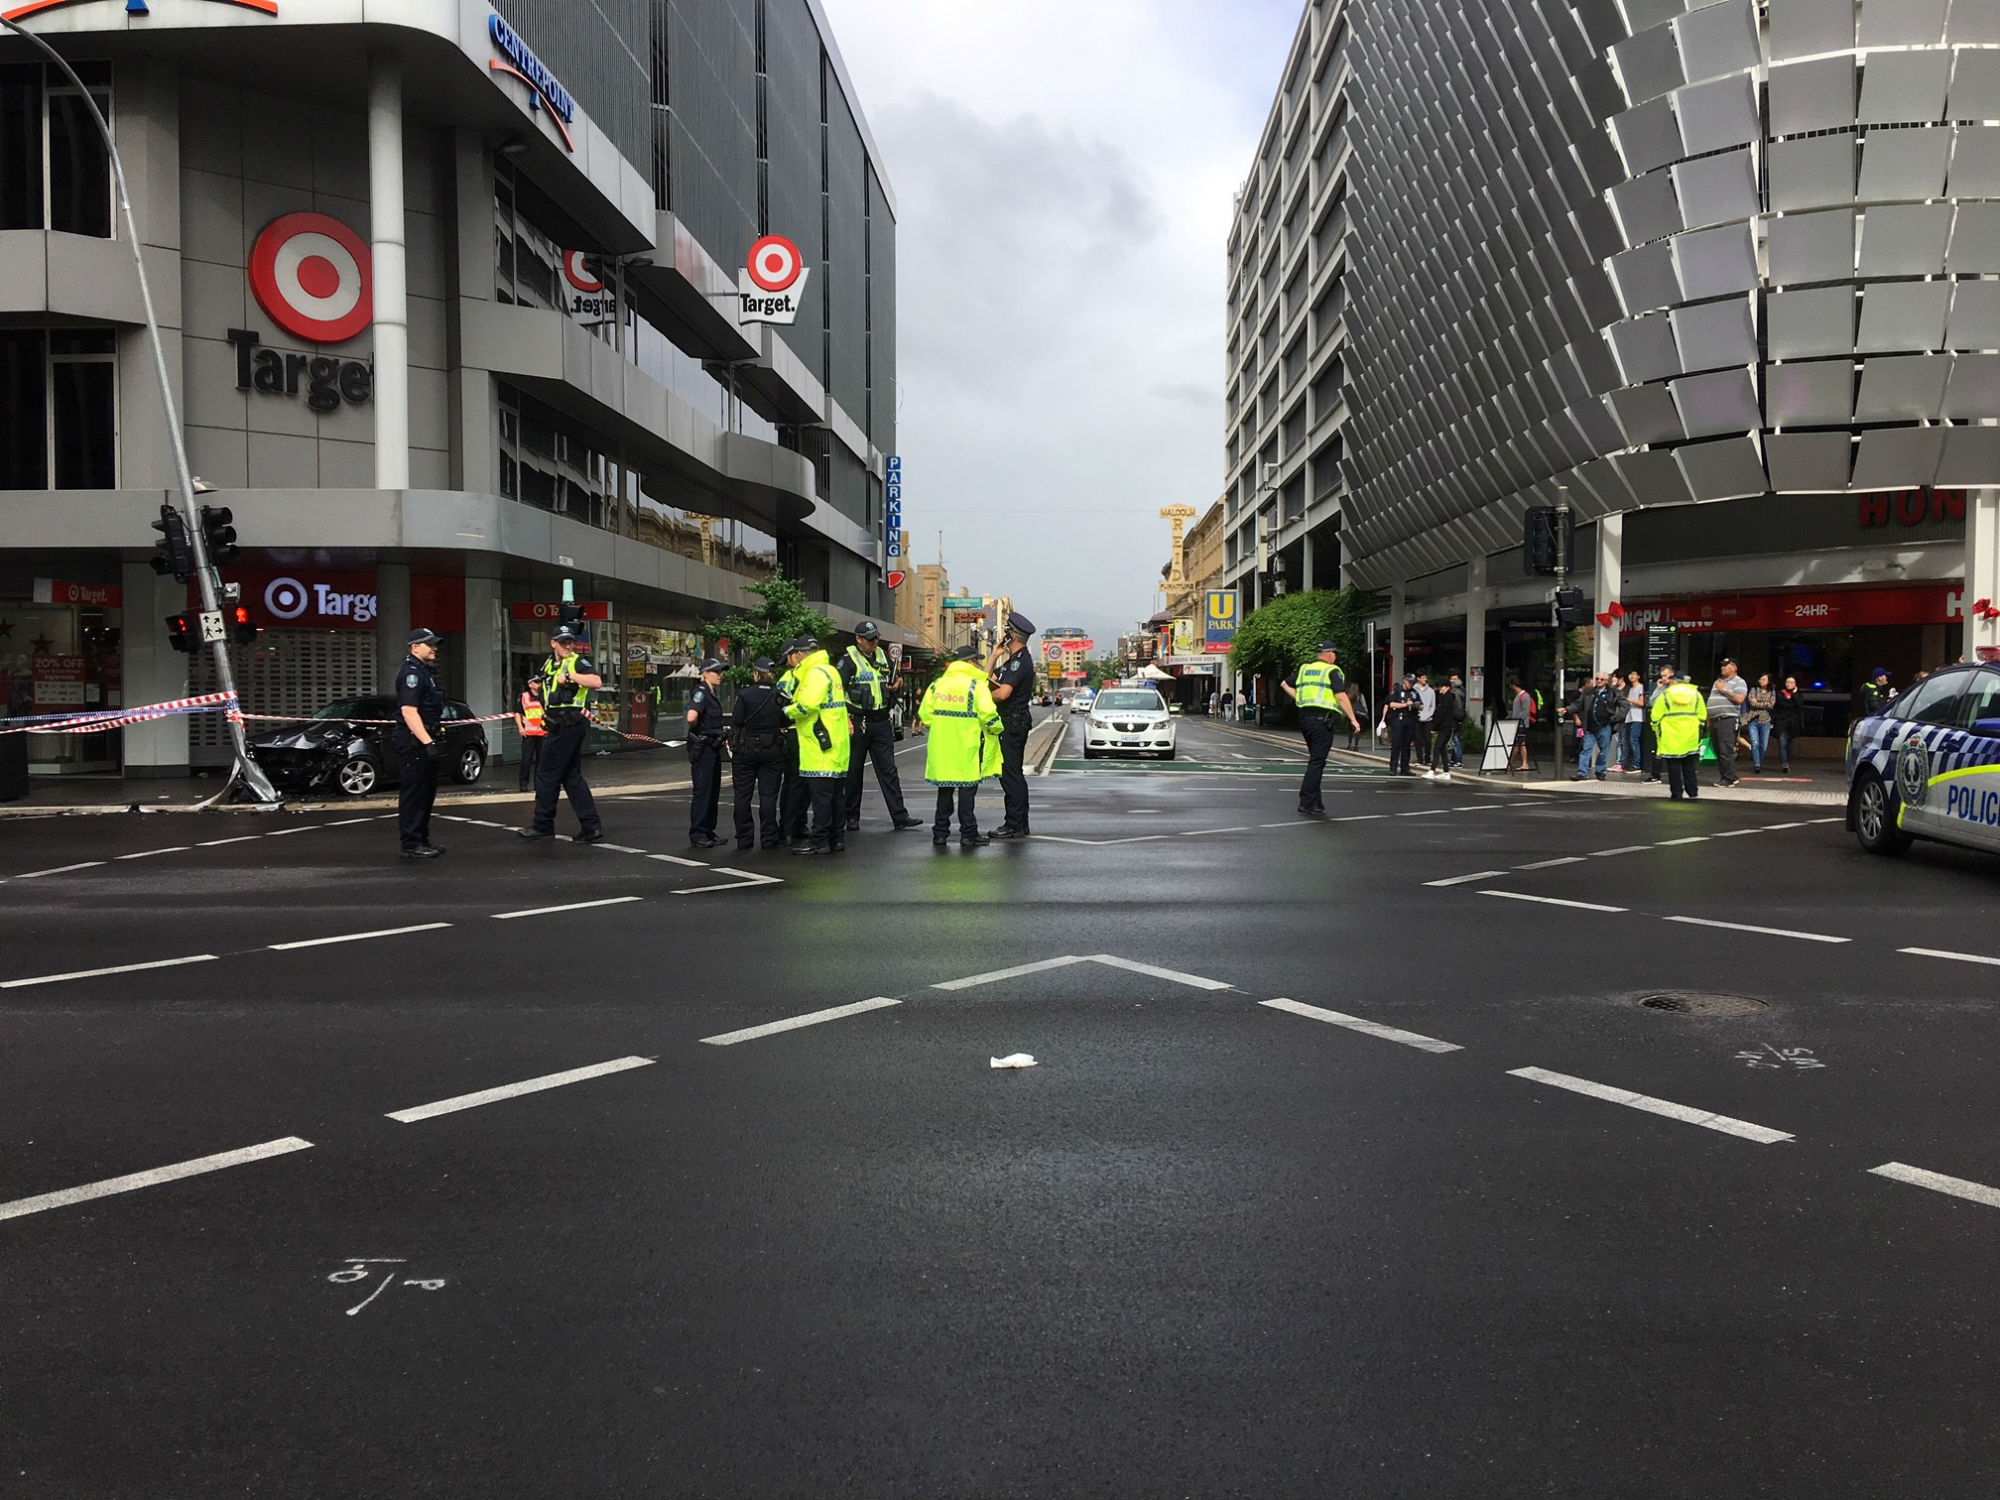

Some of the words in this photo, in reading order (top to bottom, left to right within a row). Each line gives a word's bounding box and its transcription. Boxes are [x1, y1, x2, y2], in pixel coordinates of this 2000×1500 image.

[489, 15, 574, 123] CENTREPOINT
[740, 293, 796, 316] Target.
[227, 328, 374, 411] Targe
[888, 457, 899, 556] PARKING
[1172, 518, 1183, 581] REID
[1208, 620, 1234, 630] PARK
[1209, 594, 1234, 619] U
[1794, 603, 1828, 617] 24HR
[1946, 784, 2000, 826] POLIC
